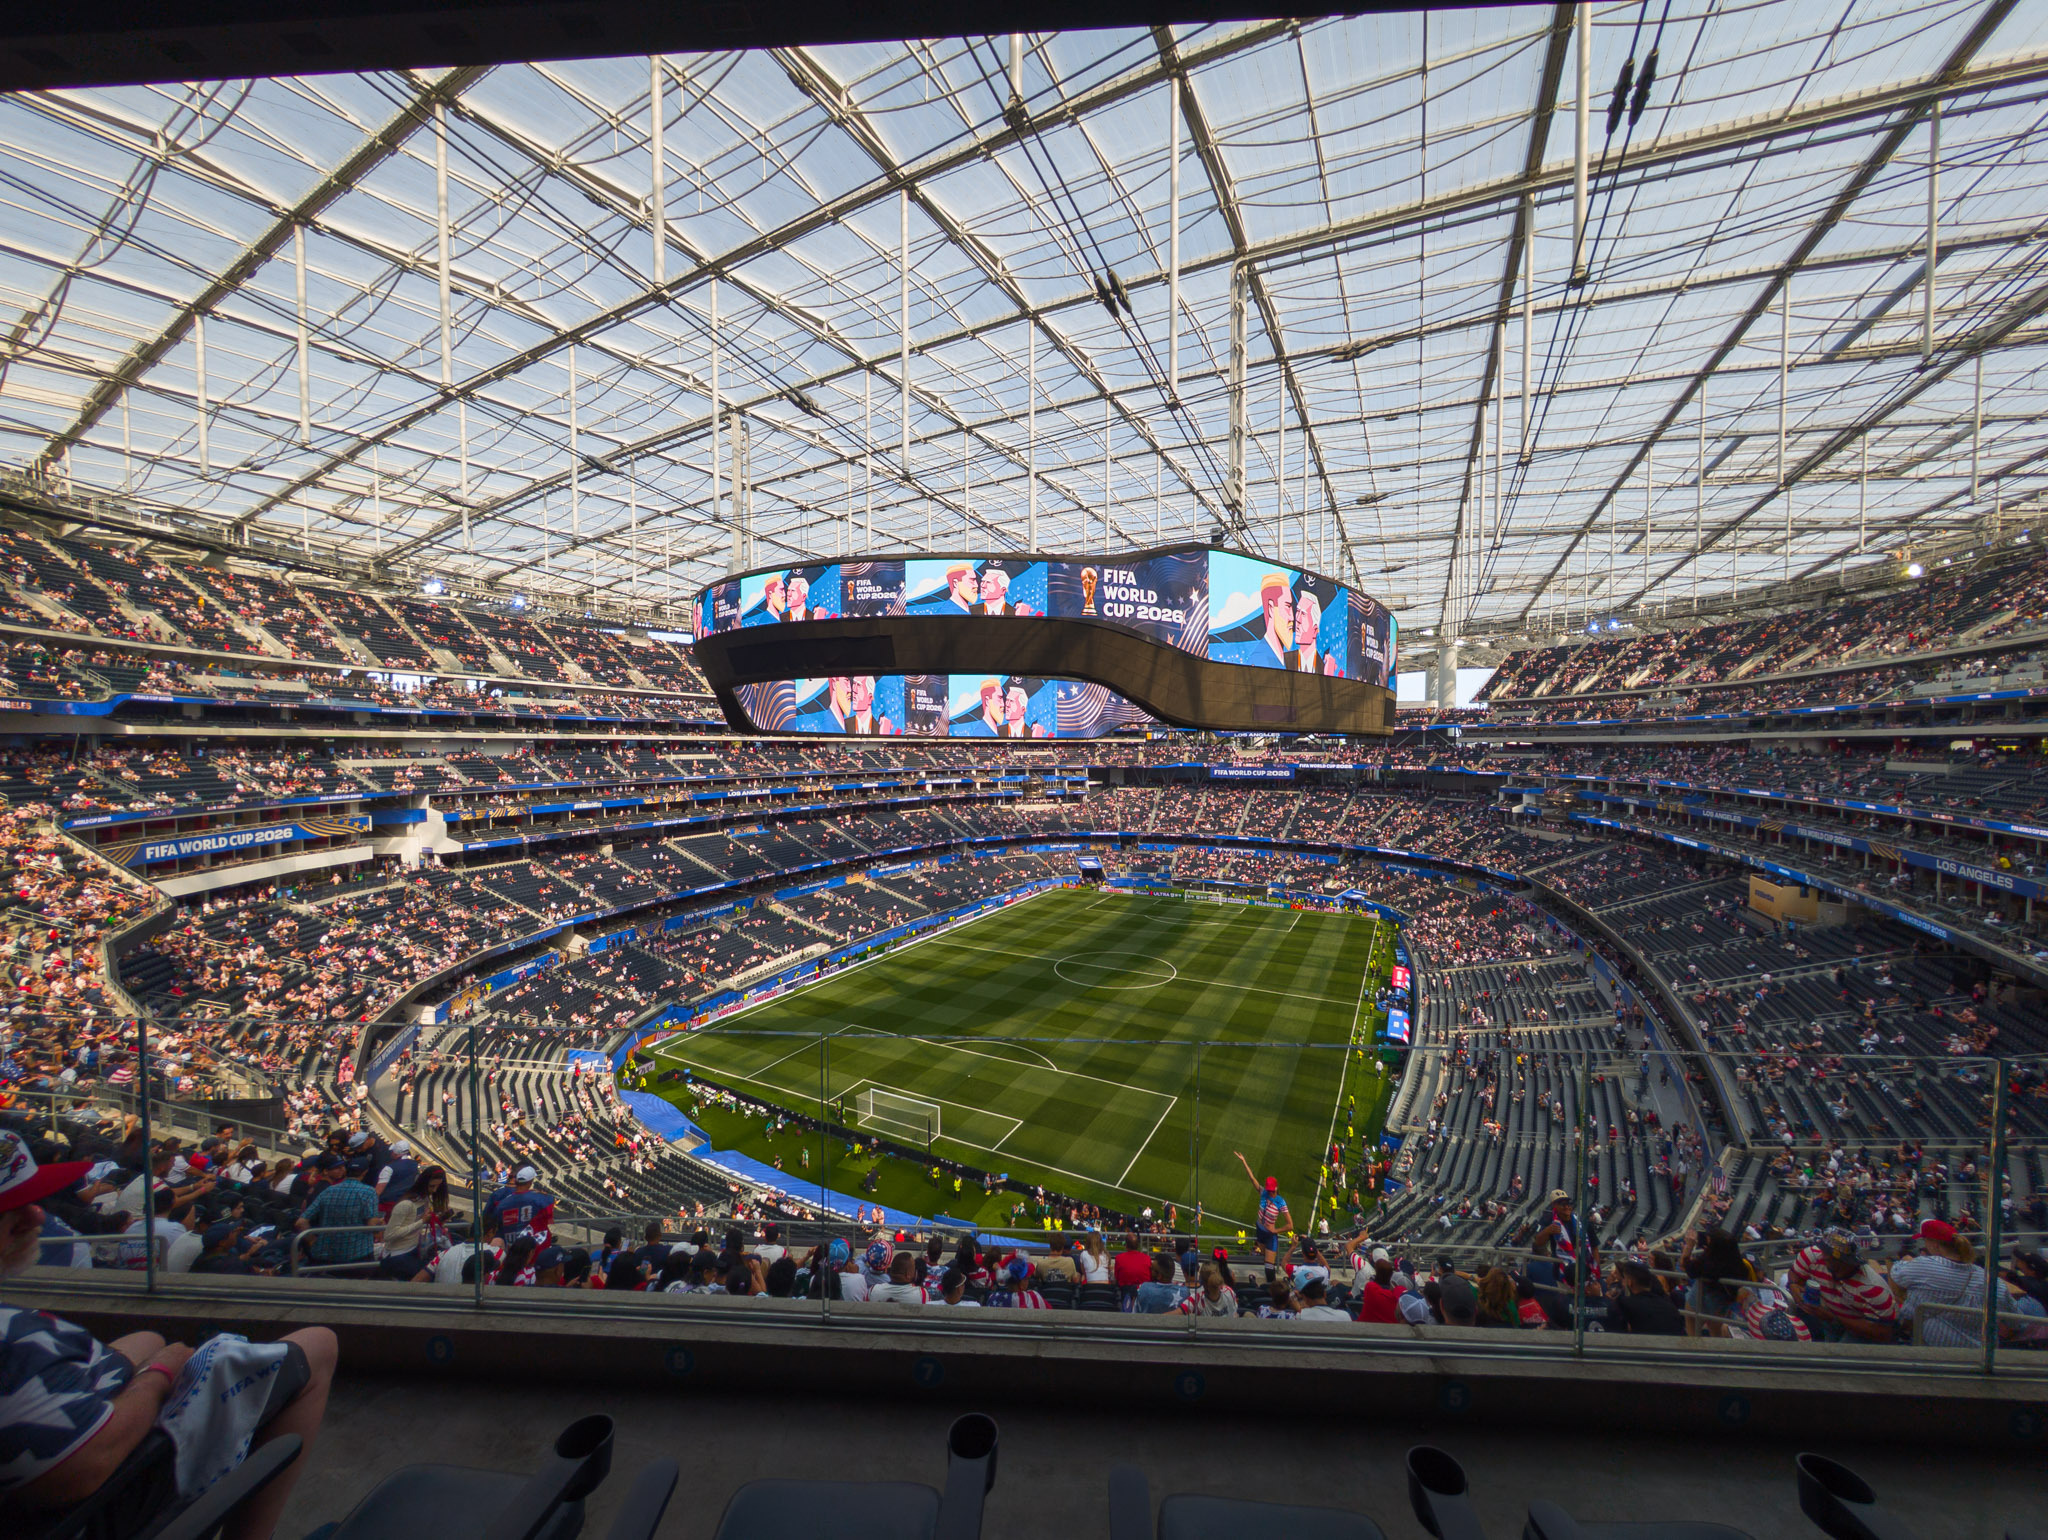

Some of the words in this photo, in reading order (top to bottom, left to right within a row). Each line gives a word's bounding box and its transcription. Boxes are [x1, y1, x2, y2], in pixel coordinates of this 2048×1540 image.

[856, 579, 872, 587] FIFA
[1103, 568, 1137, 586] FIFA
[856, 592, 871, 600] CUP
[871, 591, 898, 599] 2026
[1103, 585, 1158, 604] WORLD
[1103, 602, 1135, 618] CUP
[1136, 605, 1185, 624] 2026
[917, 703, 926, 711] CUP
[1702, 810, 1716, 818] LOS
[1716, 812, 1742, 823] ANGELES
[146, 844, 178, 859] FIFA
[178, 837, 228, 854] WORLD
[229, 832, 254, 847] CUP
[254, 827, 293, 843] 2026
[1833, 835, 1852, 846] 2026
[1936, 859, 1957, 874] LOS
[1958, 865, 2014, 889] ANGELES
[1254, 900, 1284, 908] Hisense
[820, 965, 840, 977] ULTRA
[755, 990, 778, 1003] verizon
[718, 1003, 744, 1017] verizon
[434, 1341, 446, 1359] 9
[674, 1351, 686, 1369] 8
[922, 1363, 935, 1381] 7
[221, 1377, 256, 1403] FIFA
[1183, 1376, 1197, 1394] 6
[1449, 1387, 1463, 1406] 5
[1727, 1400, 1741, 1418] 4
